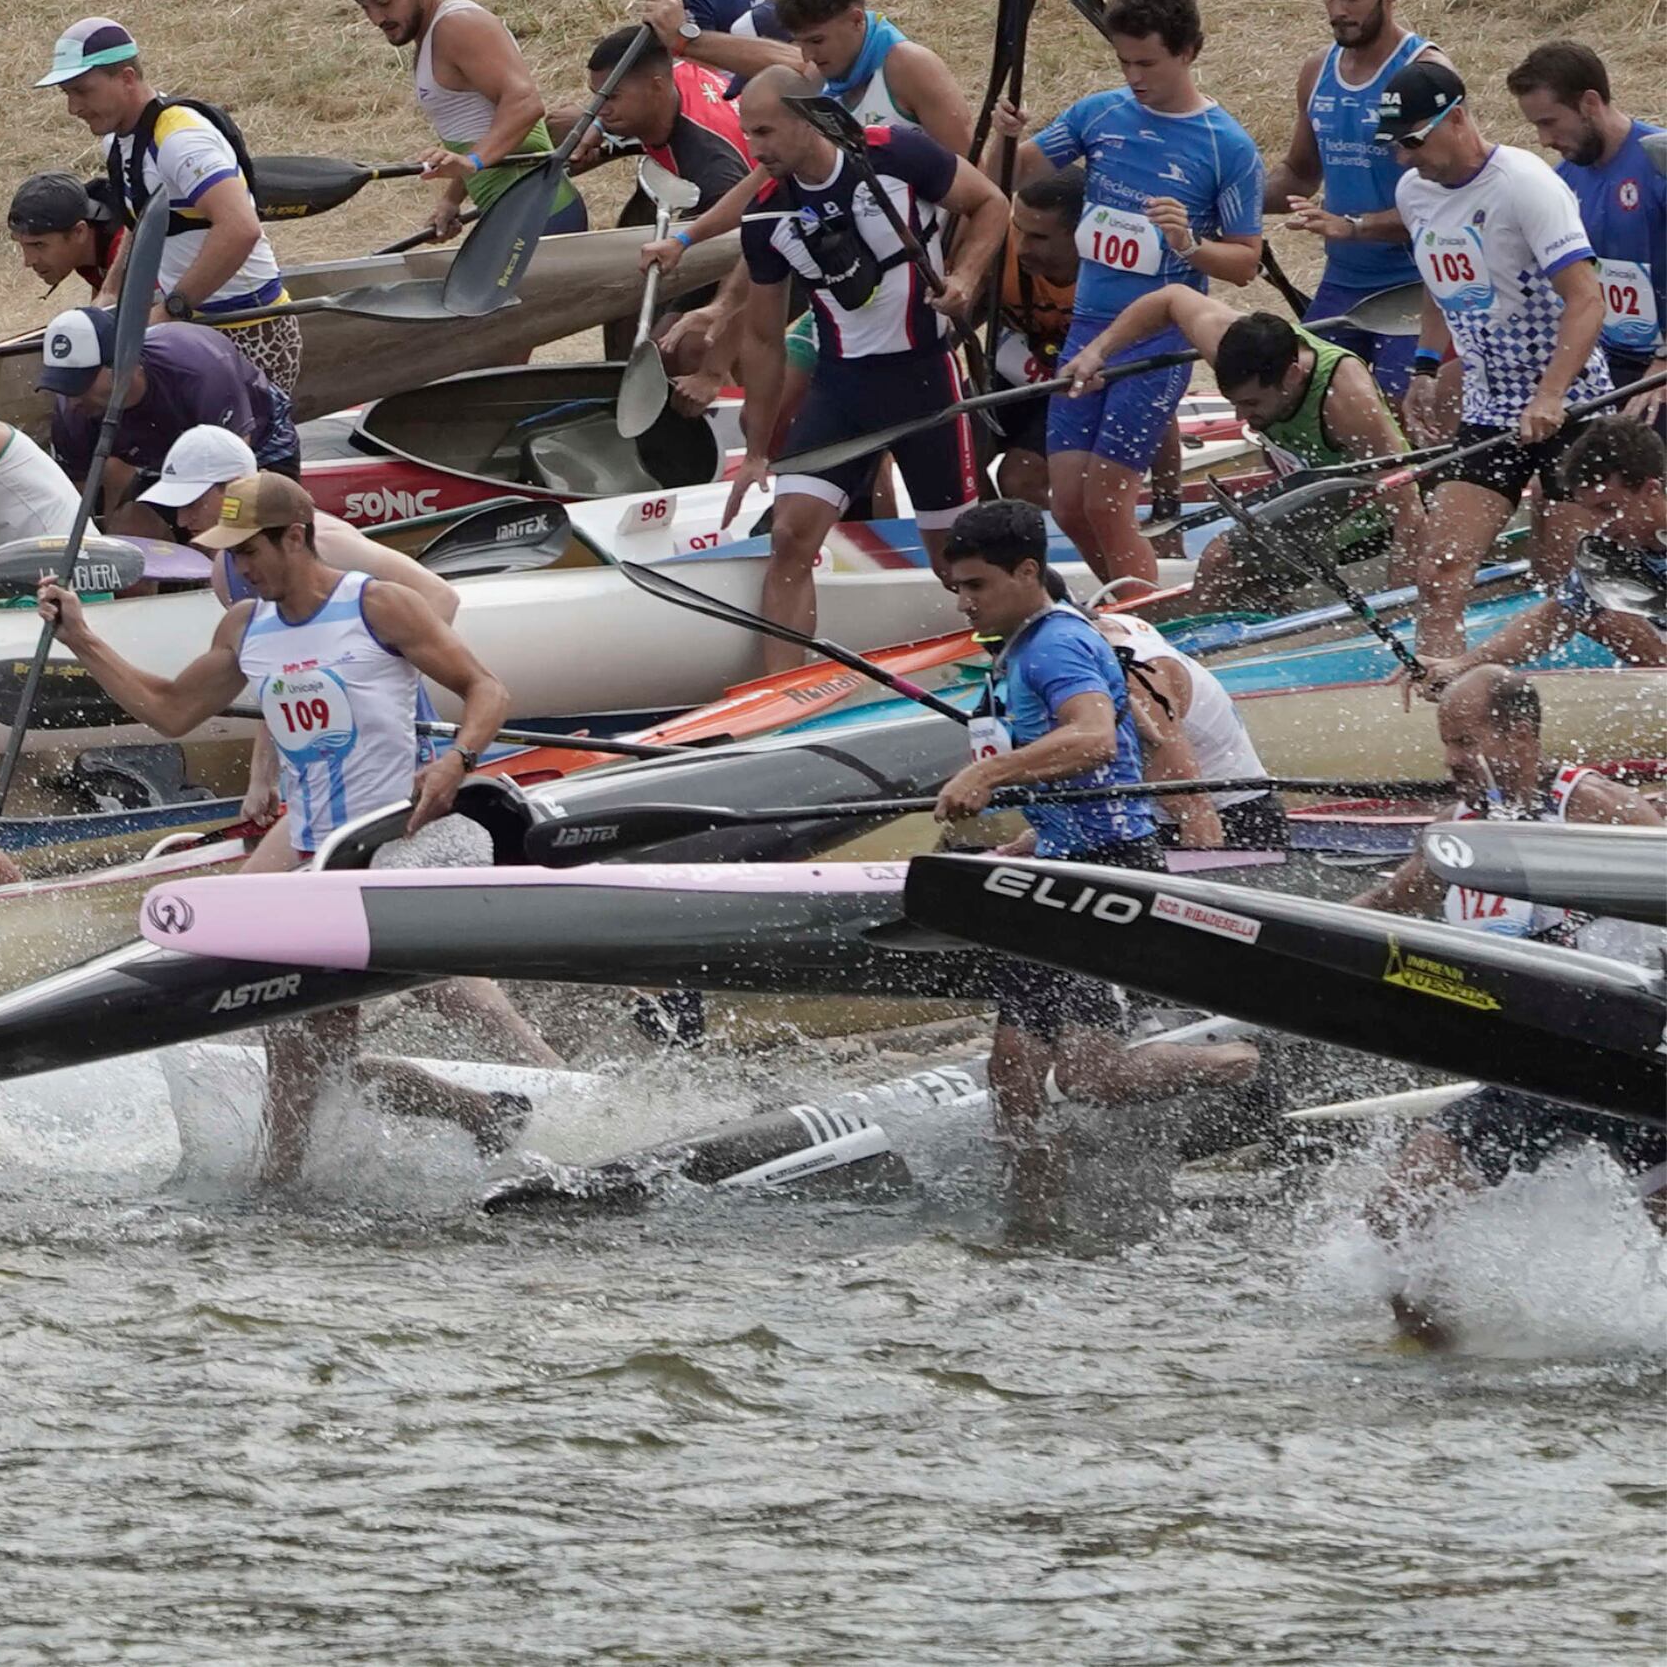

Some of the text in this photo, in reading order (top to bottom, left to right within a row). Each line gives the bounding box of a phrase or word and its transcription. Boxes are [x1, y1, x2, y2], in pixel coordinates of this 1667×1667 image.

[1108, 216, 1146, 235] Unicaja
[1092, 230, 1140, 269] 100
[1429, 252, 1476, 283] 103
[343, 486, 441, 522] SONIC
[641, 499, 667, 522] 96
[286, 680, 324, 695] Unicaja
[280, 697, 330, 733] 109
[982, 866, 1144, 926] ELIO
[1183, 907, 1256, 937] RIBADESELLA
[210, 972, 303, 1018] ASTOR
